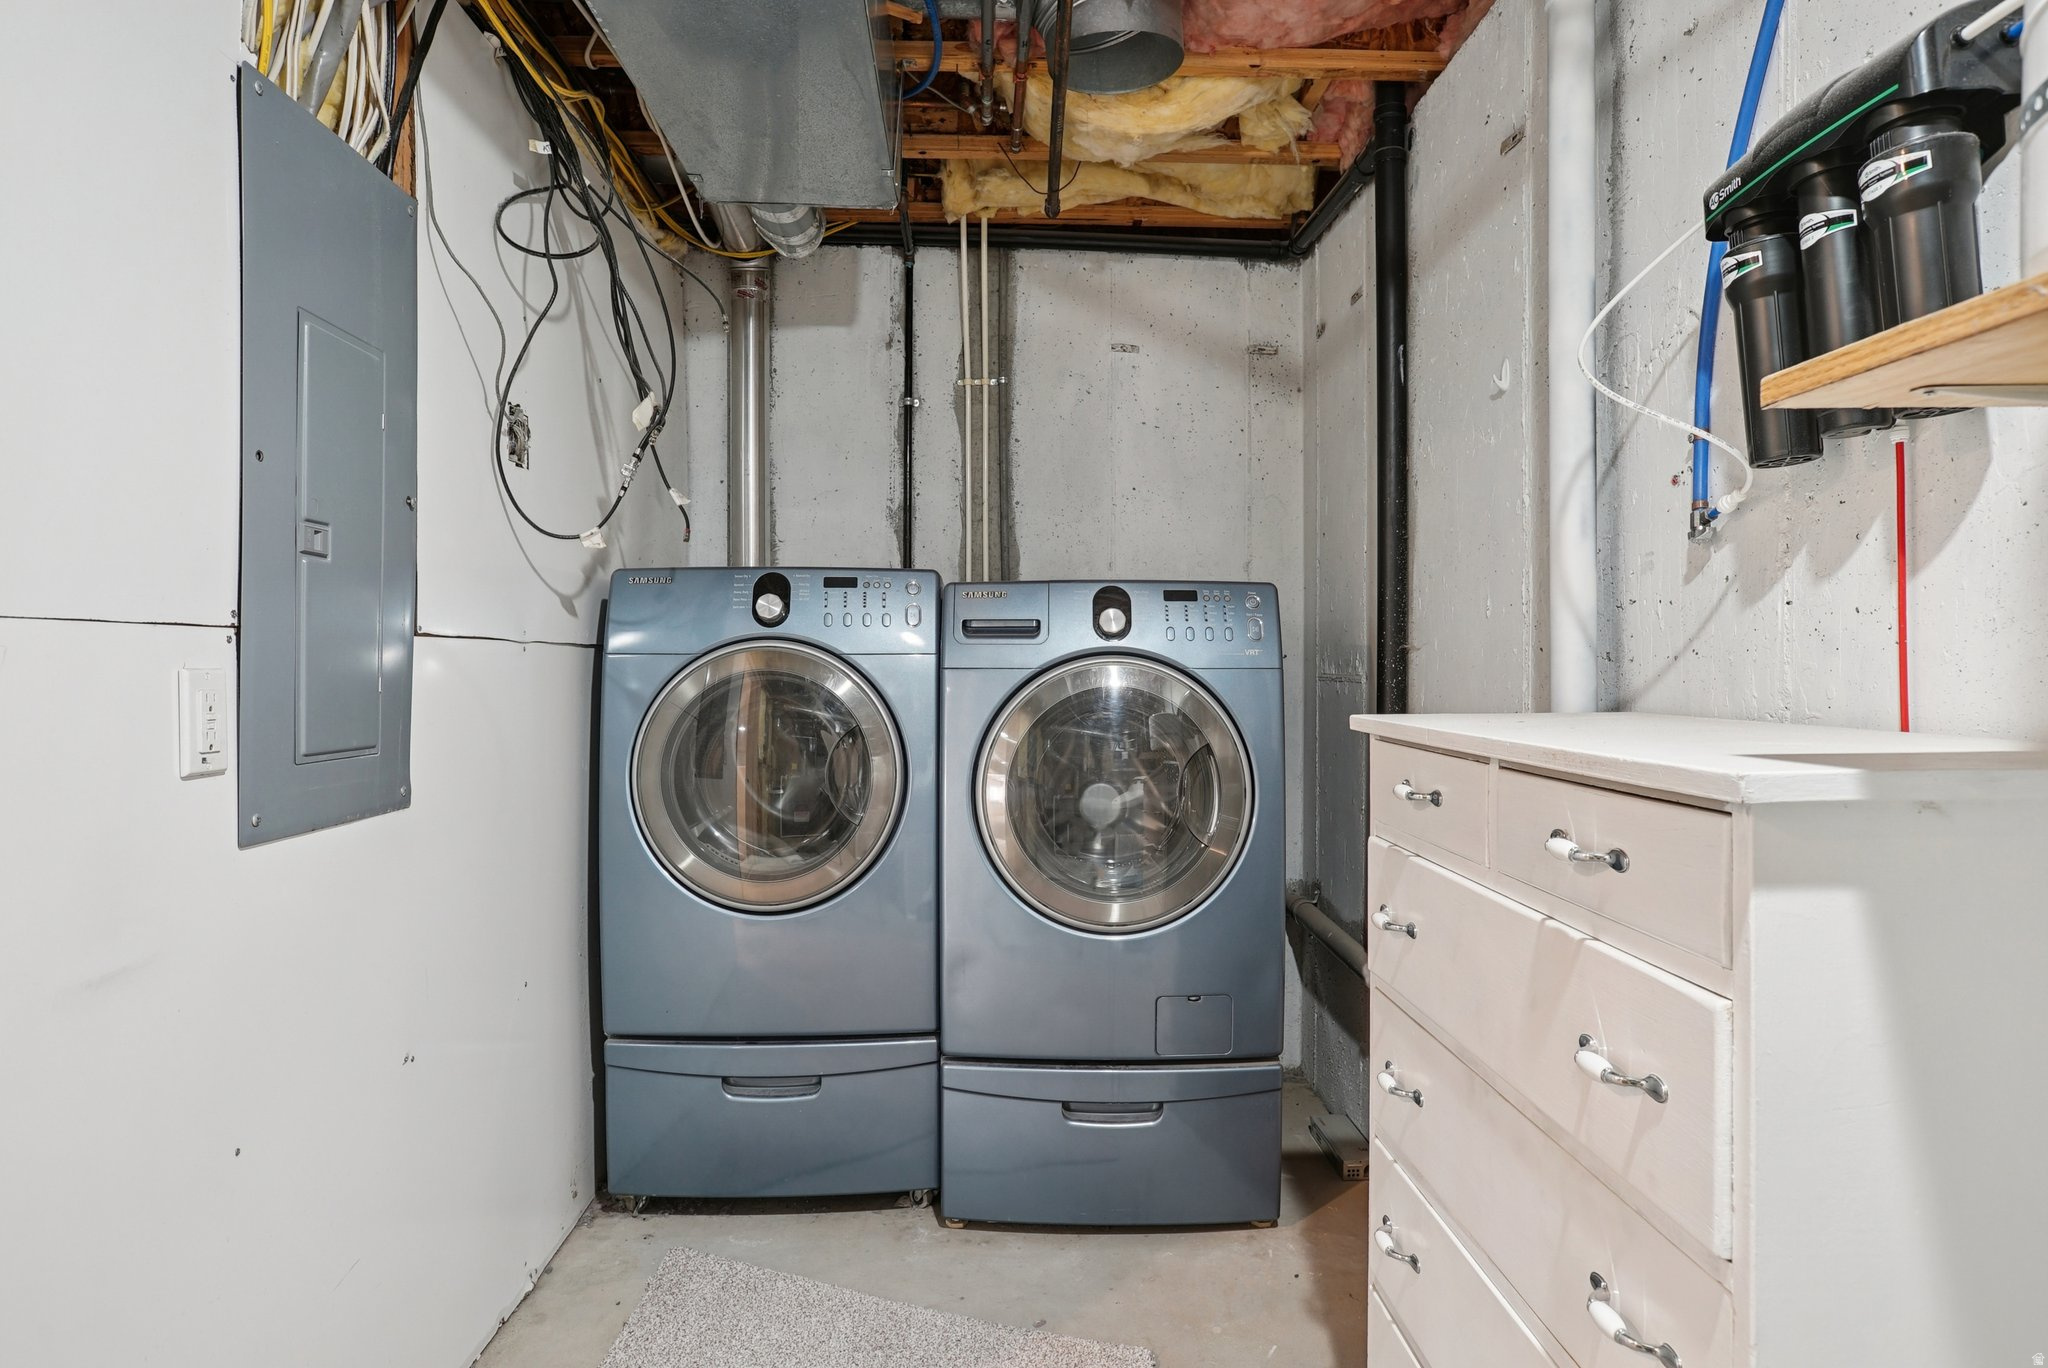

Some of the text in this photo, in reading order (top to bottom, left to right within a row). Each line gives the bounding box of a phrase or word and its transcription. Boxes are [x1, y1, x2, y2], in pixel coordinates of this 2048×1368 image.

[1719, 177, 1742, 201] Smith
[628, 576, 673, 584] SAMSUNG
[962, 591, 1008, 599] SAMSUNG
